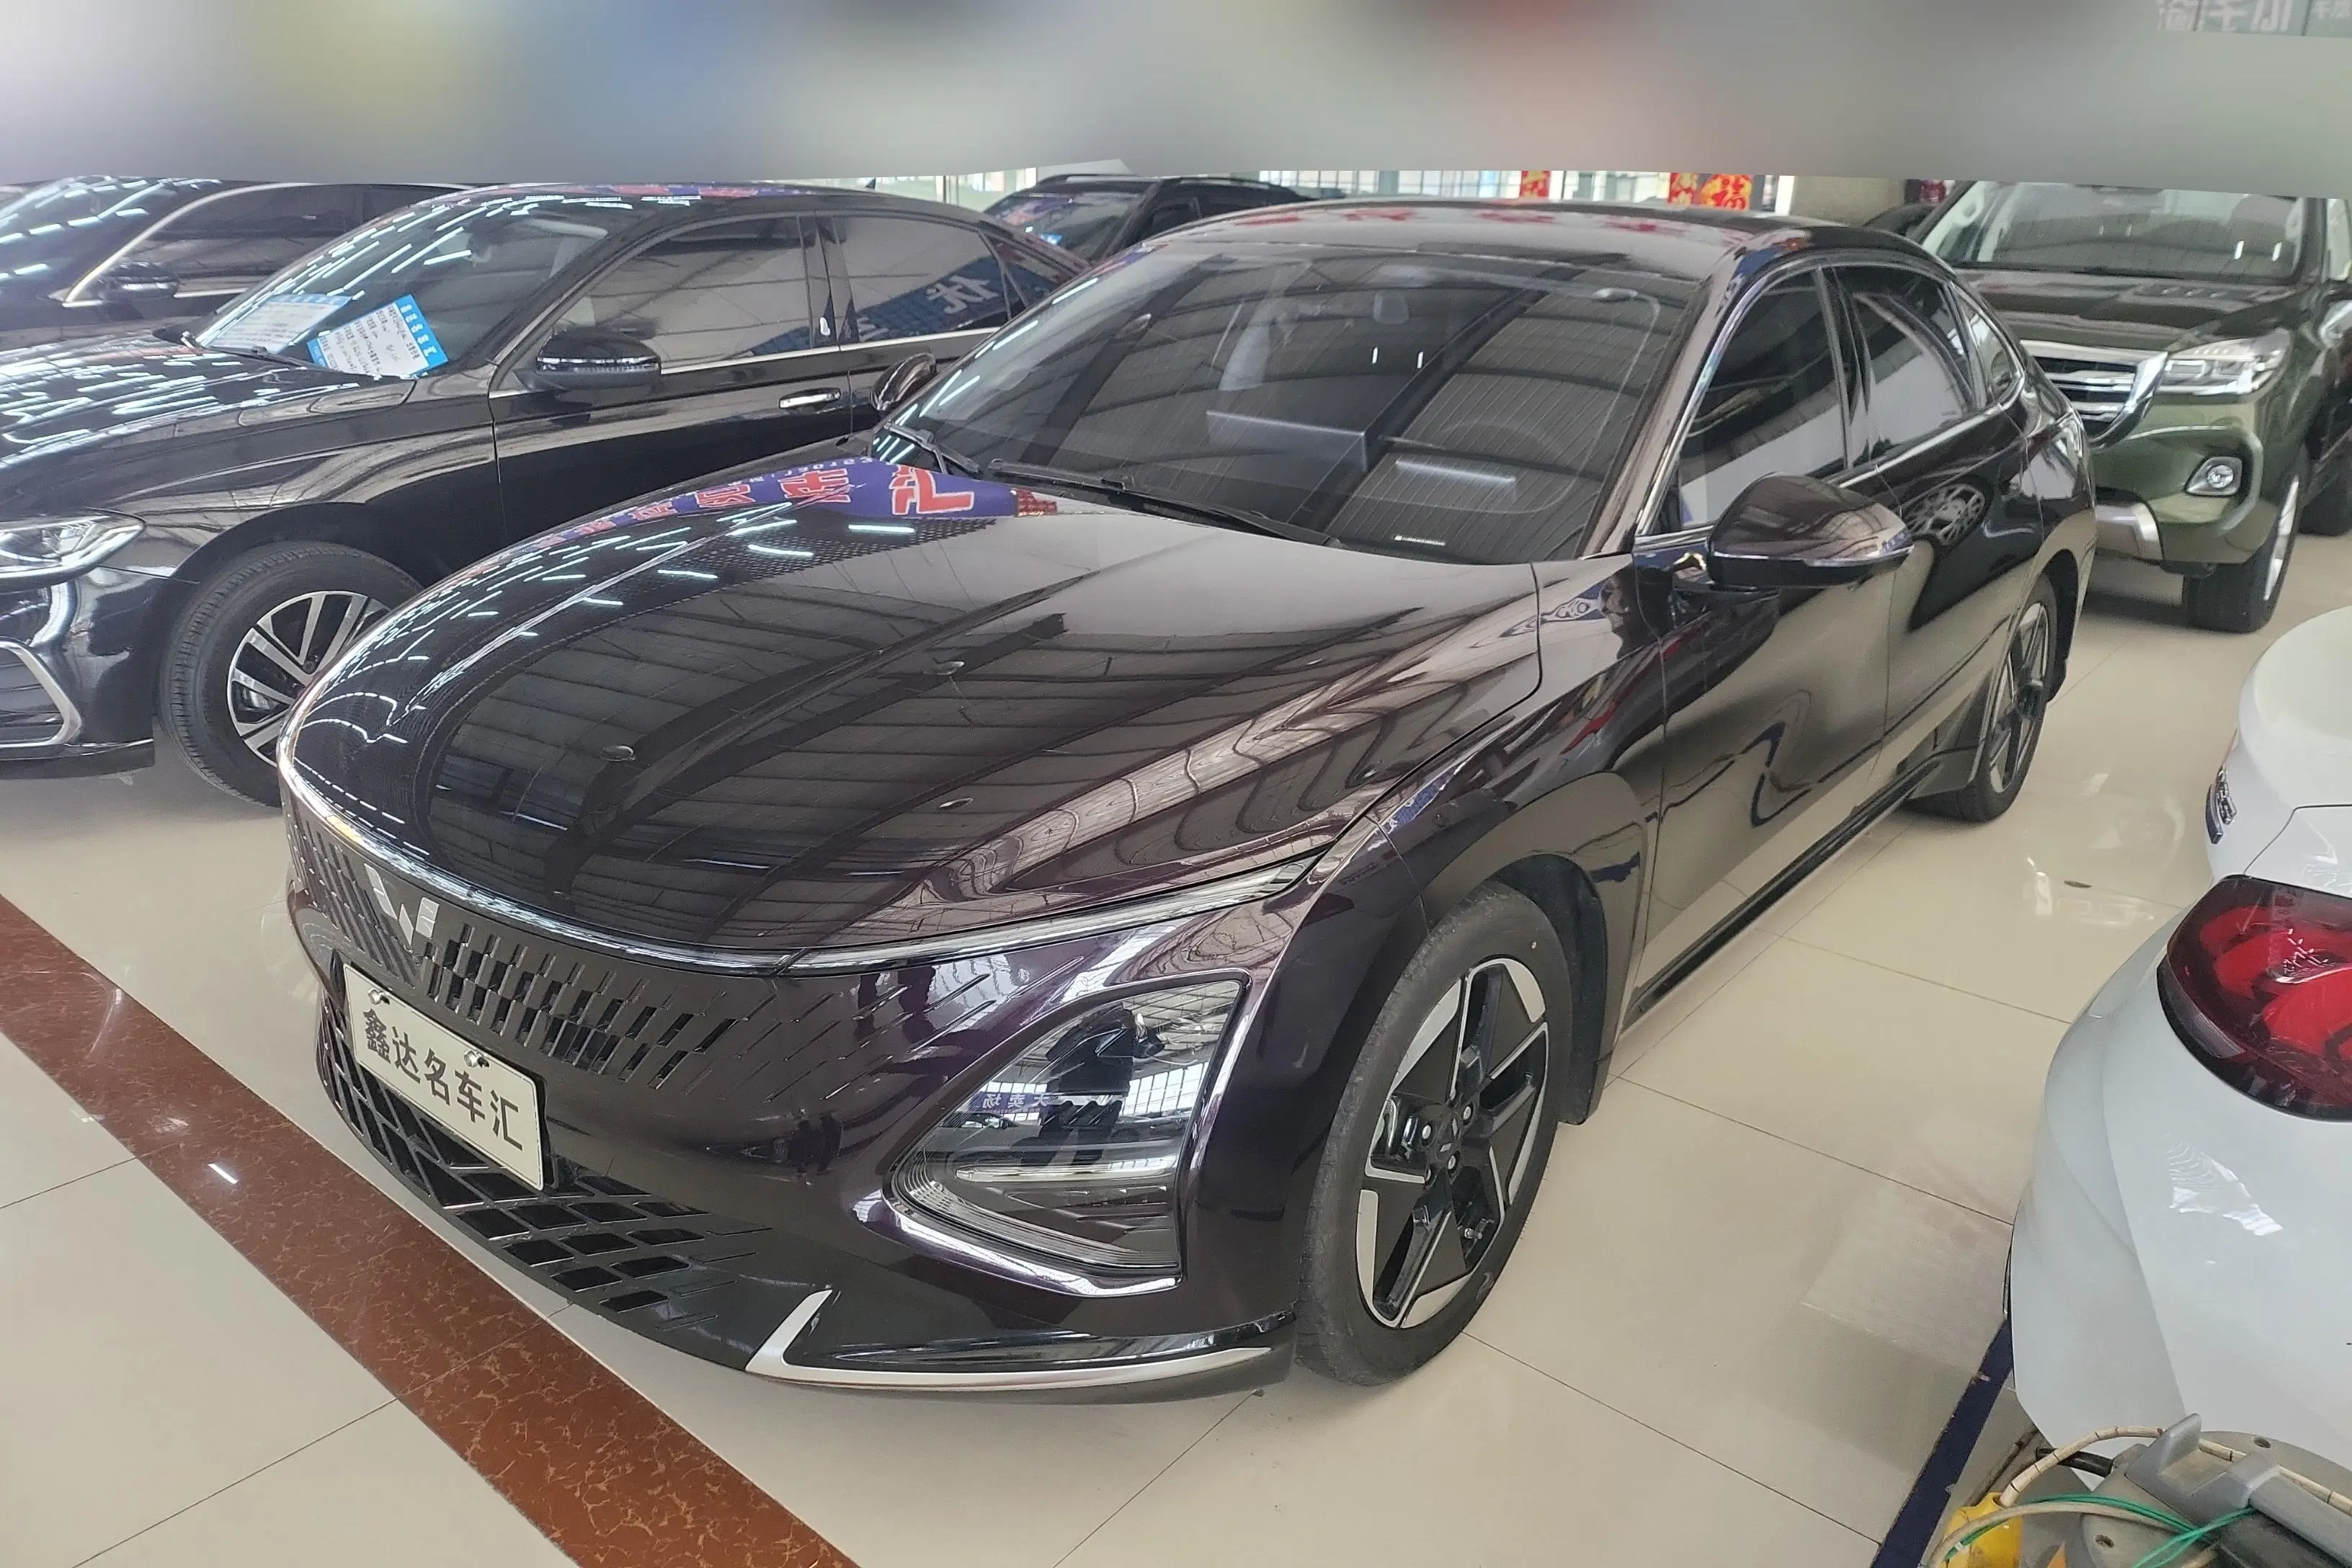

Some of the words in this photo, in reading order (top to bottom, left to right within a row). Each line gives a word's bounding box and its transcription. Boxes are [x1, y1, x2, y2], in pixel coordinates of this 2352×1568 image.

[362, 1008, 523, 1152] 鑫达名车汇
